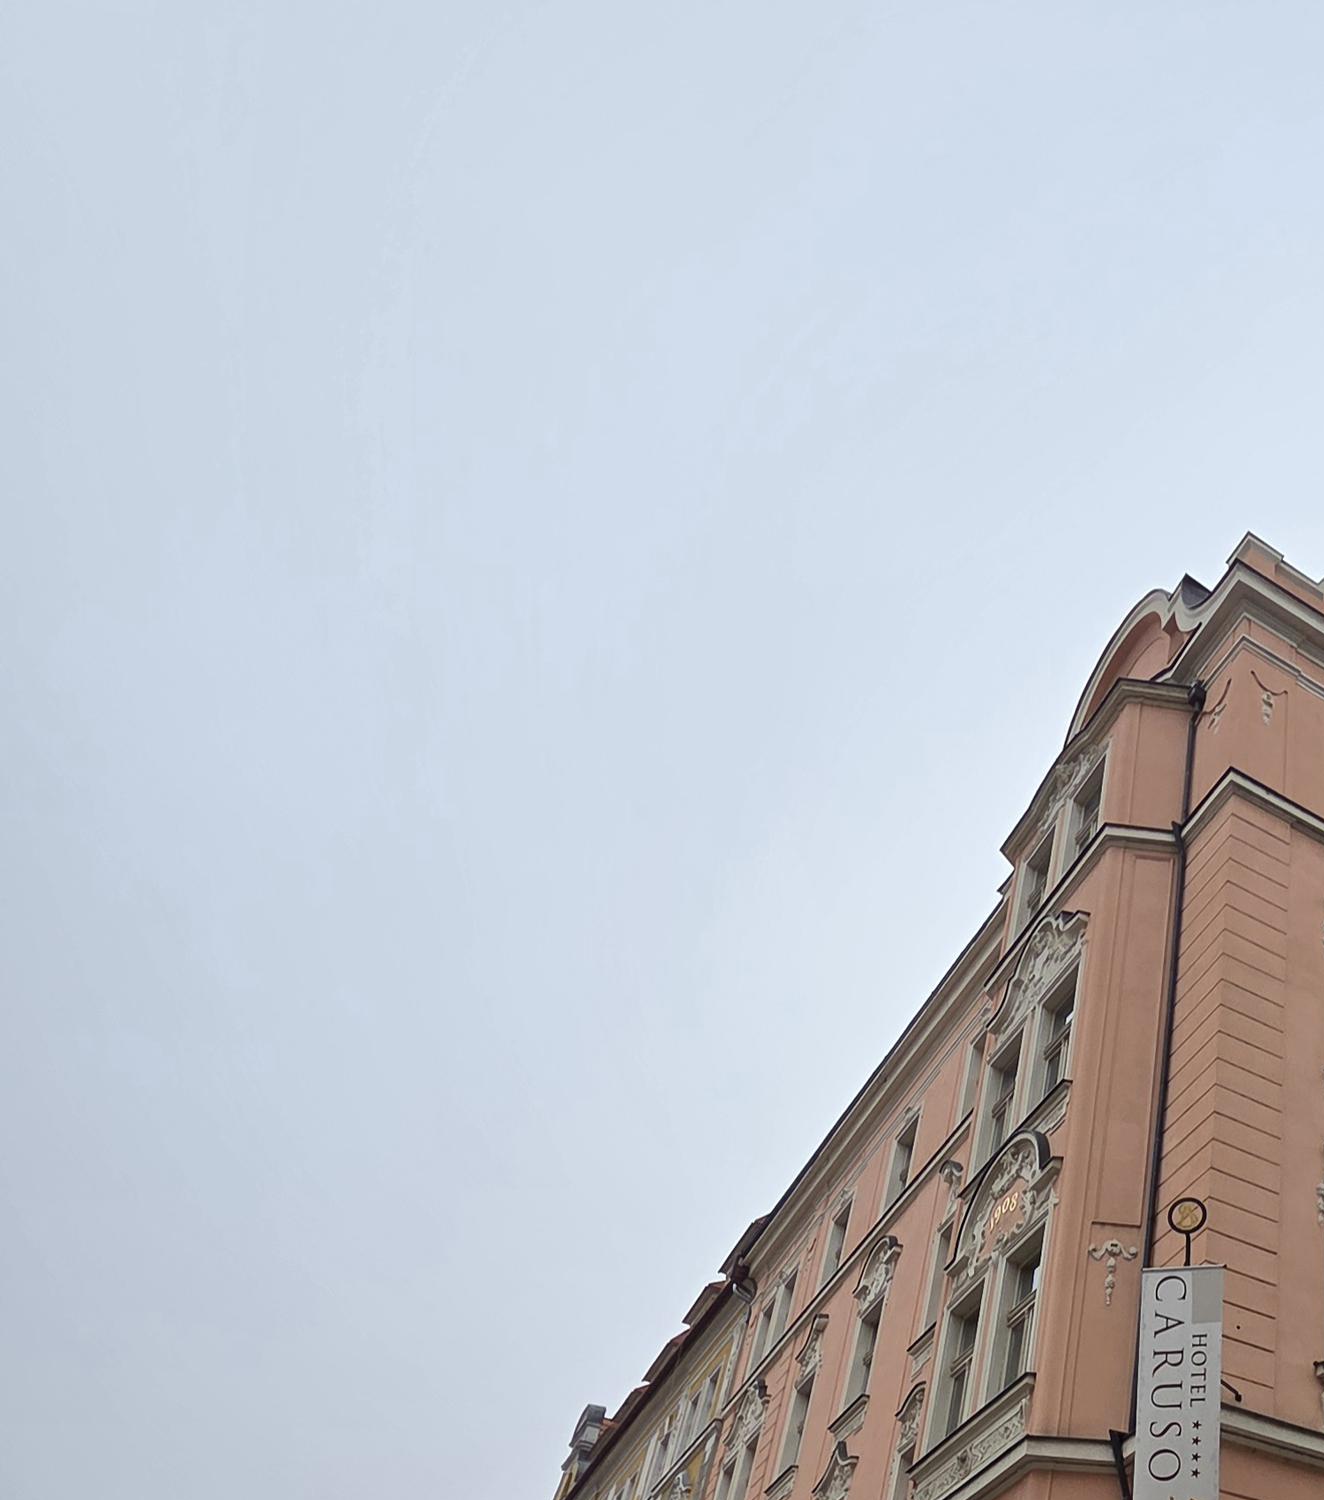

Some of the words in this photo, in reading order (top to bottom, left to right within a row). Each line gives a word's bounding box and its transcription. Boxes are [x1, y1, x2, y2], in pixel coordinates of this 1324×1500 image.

[990, 1192, 1018, 1231] 1908
[1148, 1275, 1187, 1481] CARUSO
[1190, 1334, 1208, 1408] HOTEL
